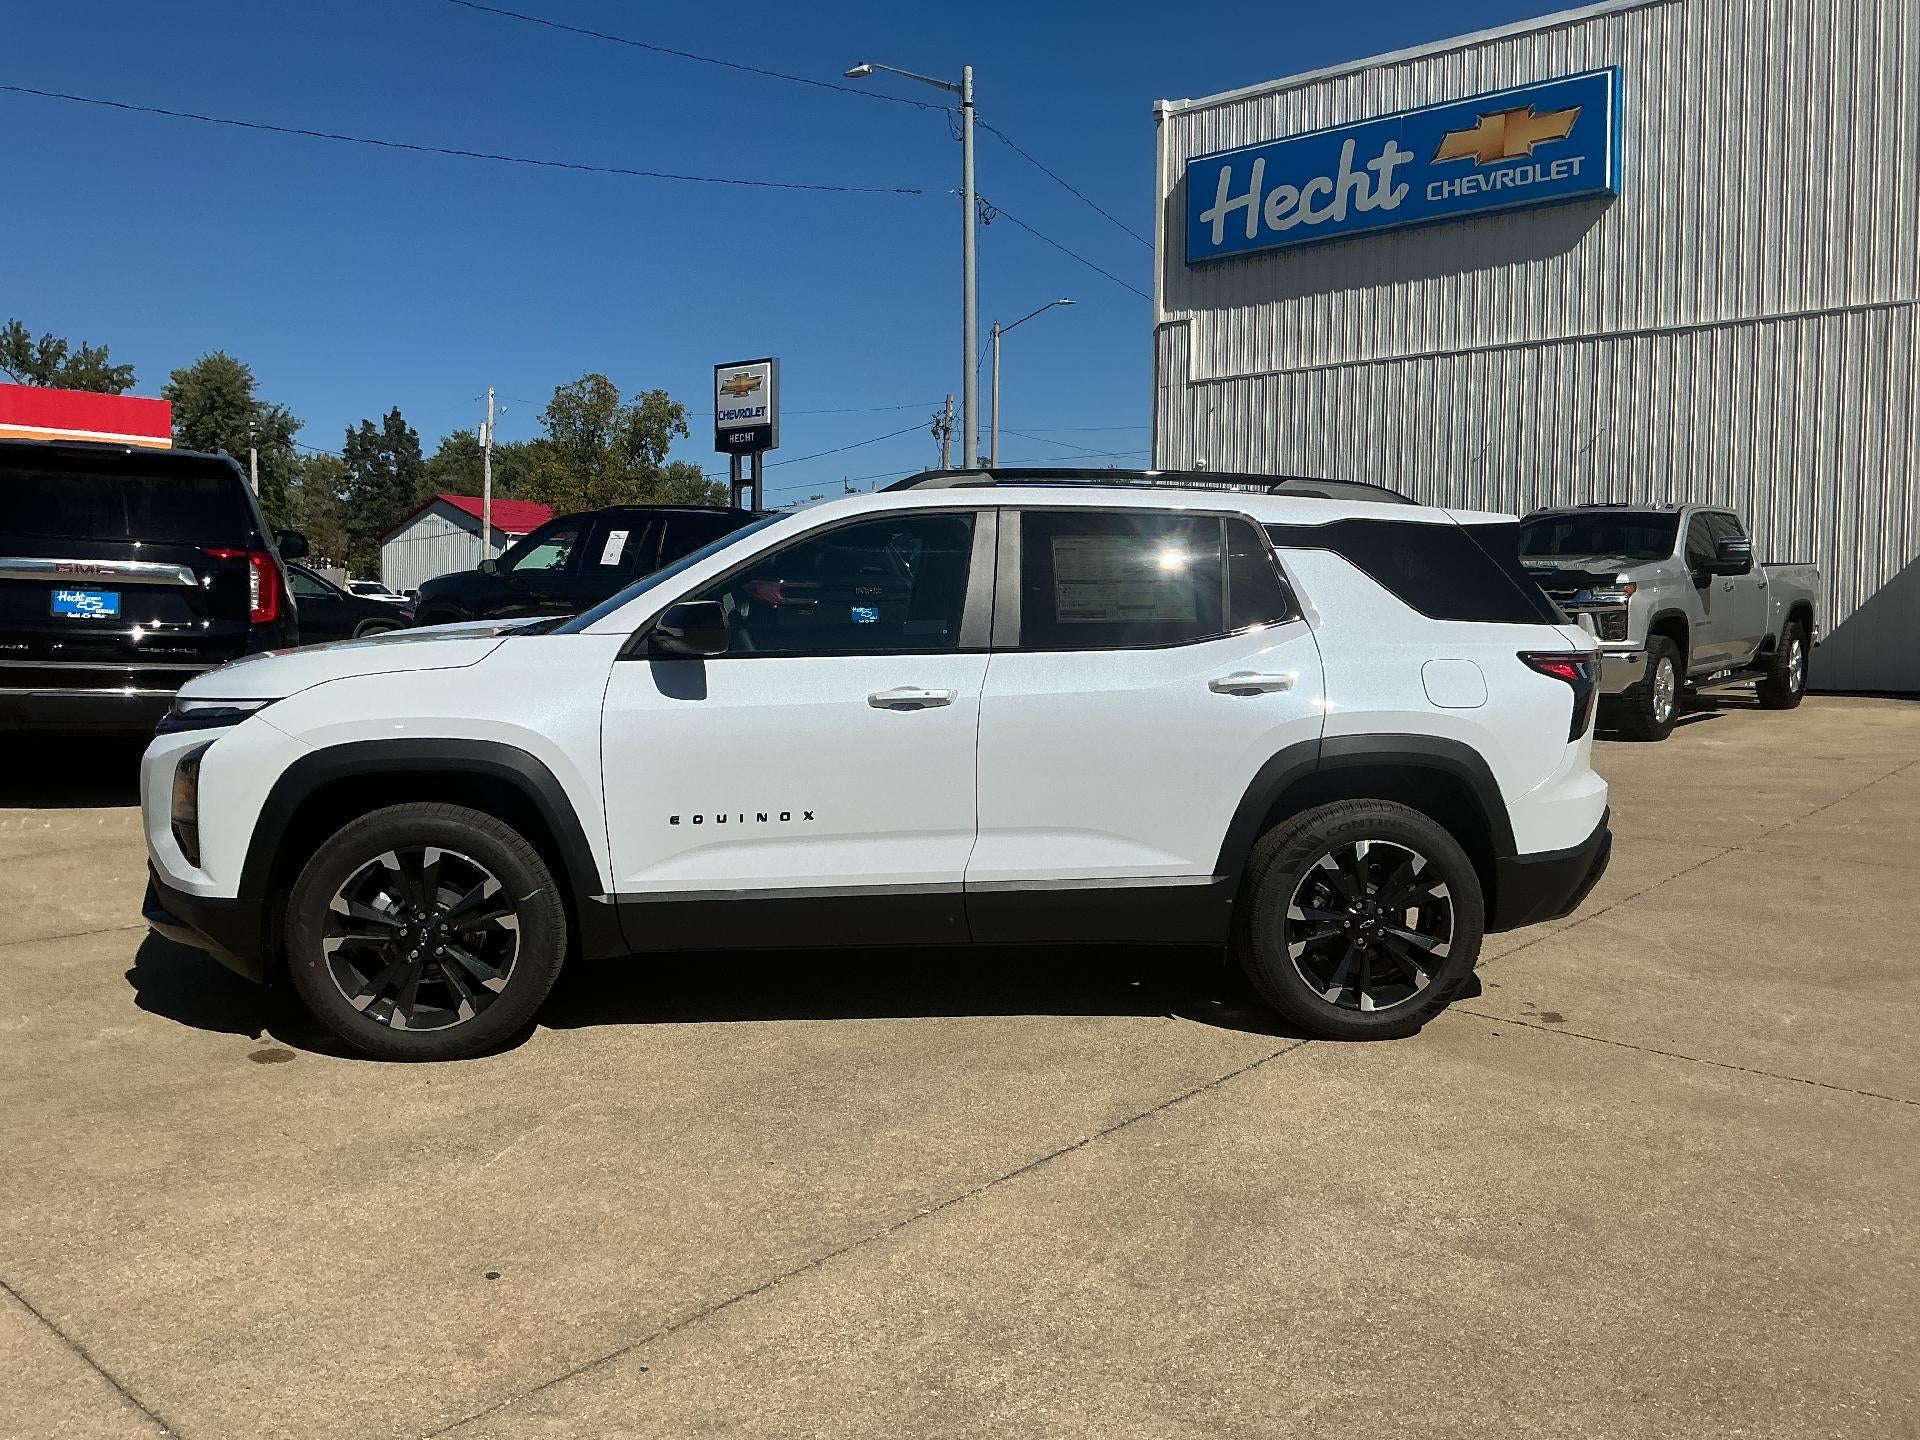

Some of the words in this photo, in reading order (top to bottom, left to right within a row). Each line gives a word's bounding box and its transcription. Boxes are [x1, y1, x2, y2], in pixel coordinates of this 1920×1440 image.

[1426, 156, 1585, 201] CHEVROLET
[1200, 138, 1414, 246] Hecht
[719, 406, 766, 421] CHEVROLET
[730, 432, 754, 443] HECHT
[57, 590, 86, 602] Hecht
[670, 811, 814, 825] EQUINOX
